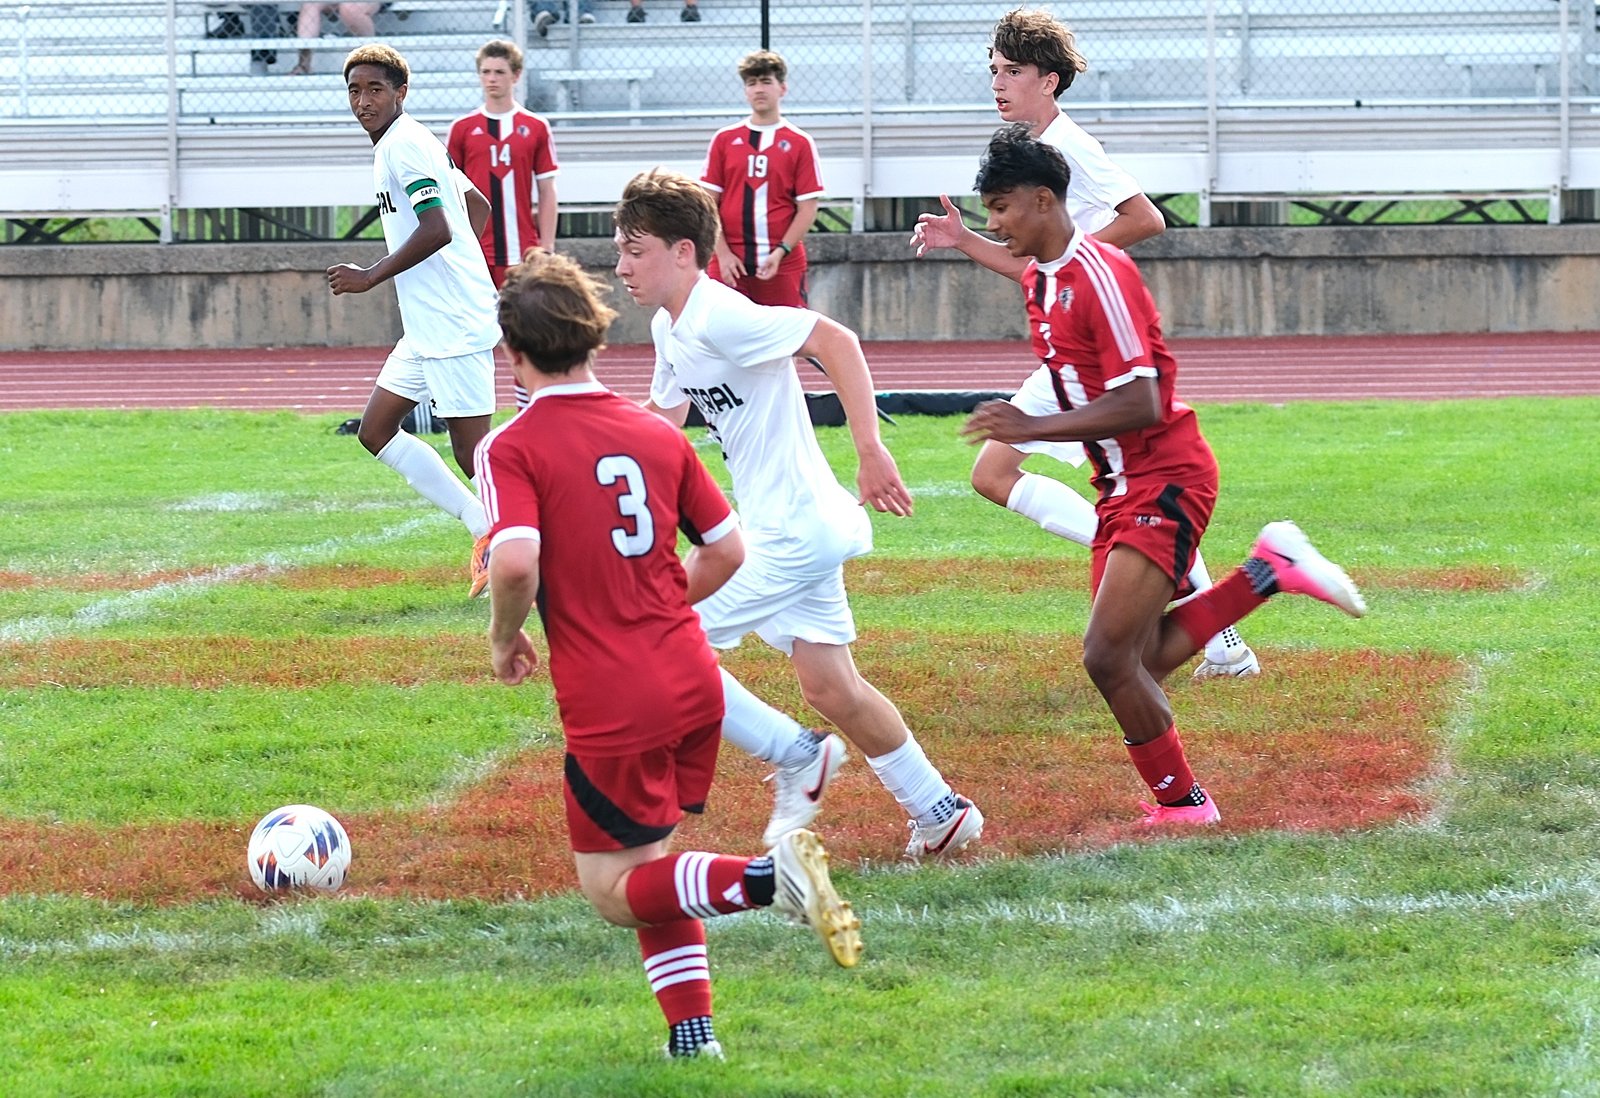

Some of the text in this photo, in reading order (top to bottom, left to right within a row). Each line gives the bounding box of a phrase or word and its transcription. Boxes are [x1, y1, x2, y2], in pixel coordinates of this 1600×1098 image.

[489, 143, 512, 167] 14
[747, 154, 769, 178] 19
[595, 453, 655, 557] 3
